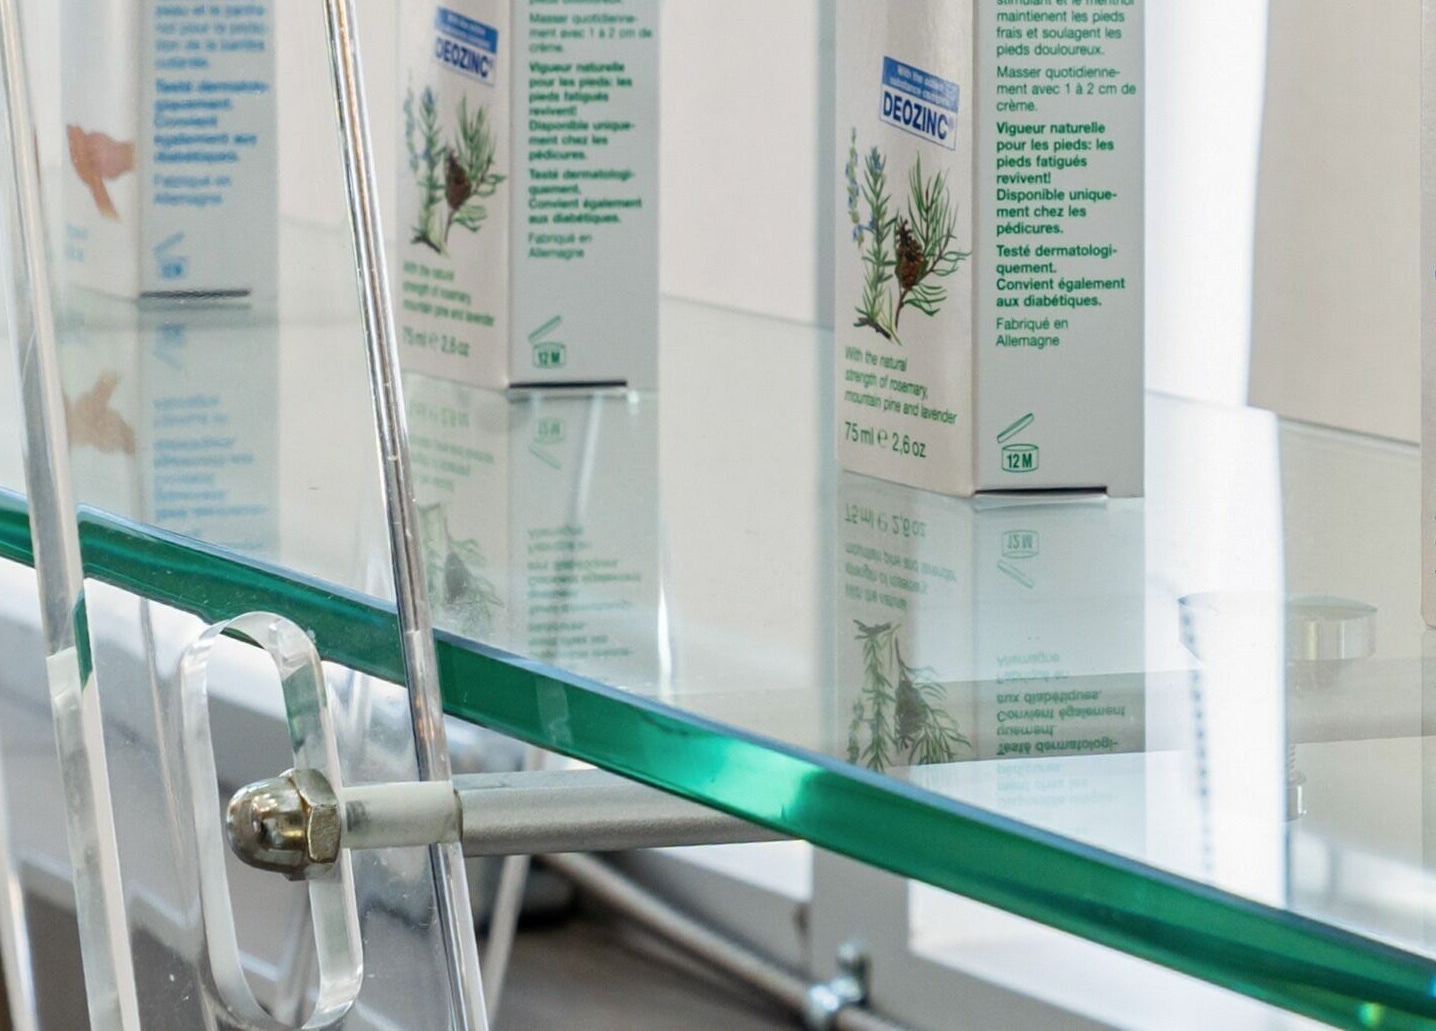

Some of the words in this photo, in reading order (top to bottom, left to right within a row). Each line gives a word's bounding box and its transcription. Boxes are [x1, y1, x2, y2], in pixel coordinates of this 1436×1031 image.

[996, 122, 1045, 137] Vigueur
[1050, 122, 1105, 134] naturelle
[996, 141, 1026, 153] pour
[1030, 138, 1049, 151] les
[1095, 138, 1114, 151] les
[996, 155, 1032, 170] pieds
[996, 172, 1053, 184] revivent!
[996, 188, 1065, 202] Disponible
[1069, 189, 1119, 203] unique-
[996, 206, 1030, 218] ment
[1033, 206, 1065, 217] chez
[1067, 205, 1087, 217] les
[1035, 244, 1118, 259] dermatologi-
[996, 263, 1058, 276] quement.
[996, 278, 1054, 291] Convient
[996, 297, 1019, 307] aux
[1054, 319, 1068, 330] en
[996, 334, 1060, 350] Allemagne
[892, 432, 910, 455] 2,6
[912, 441, 926, 458] oz
